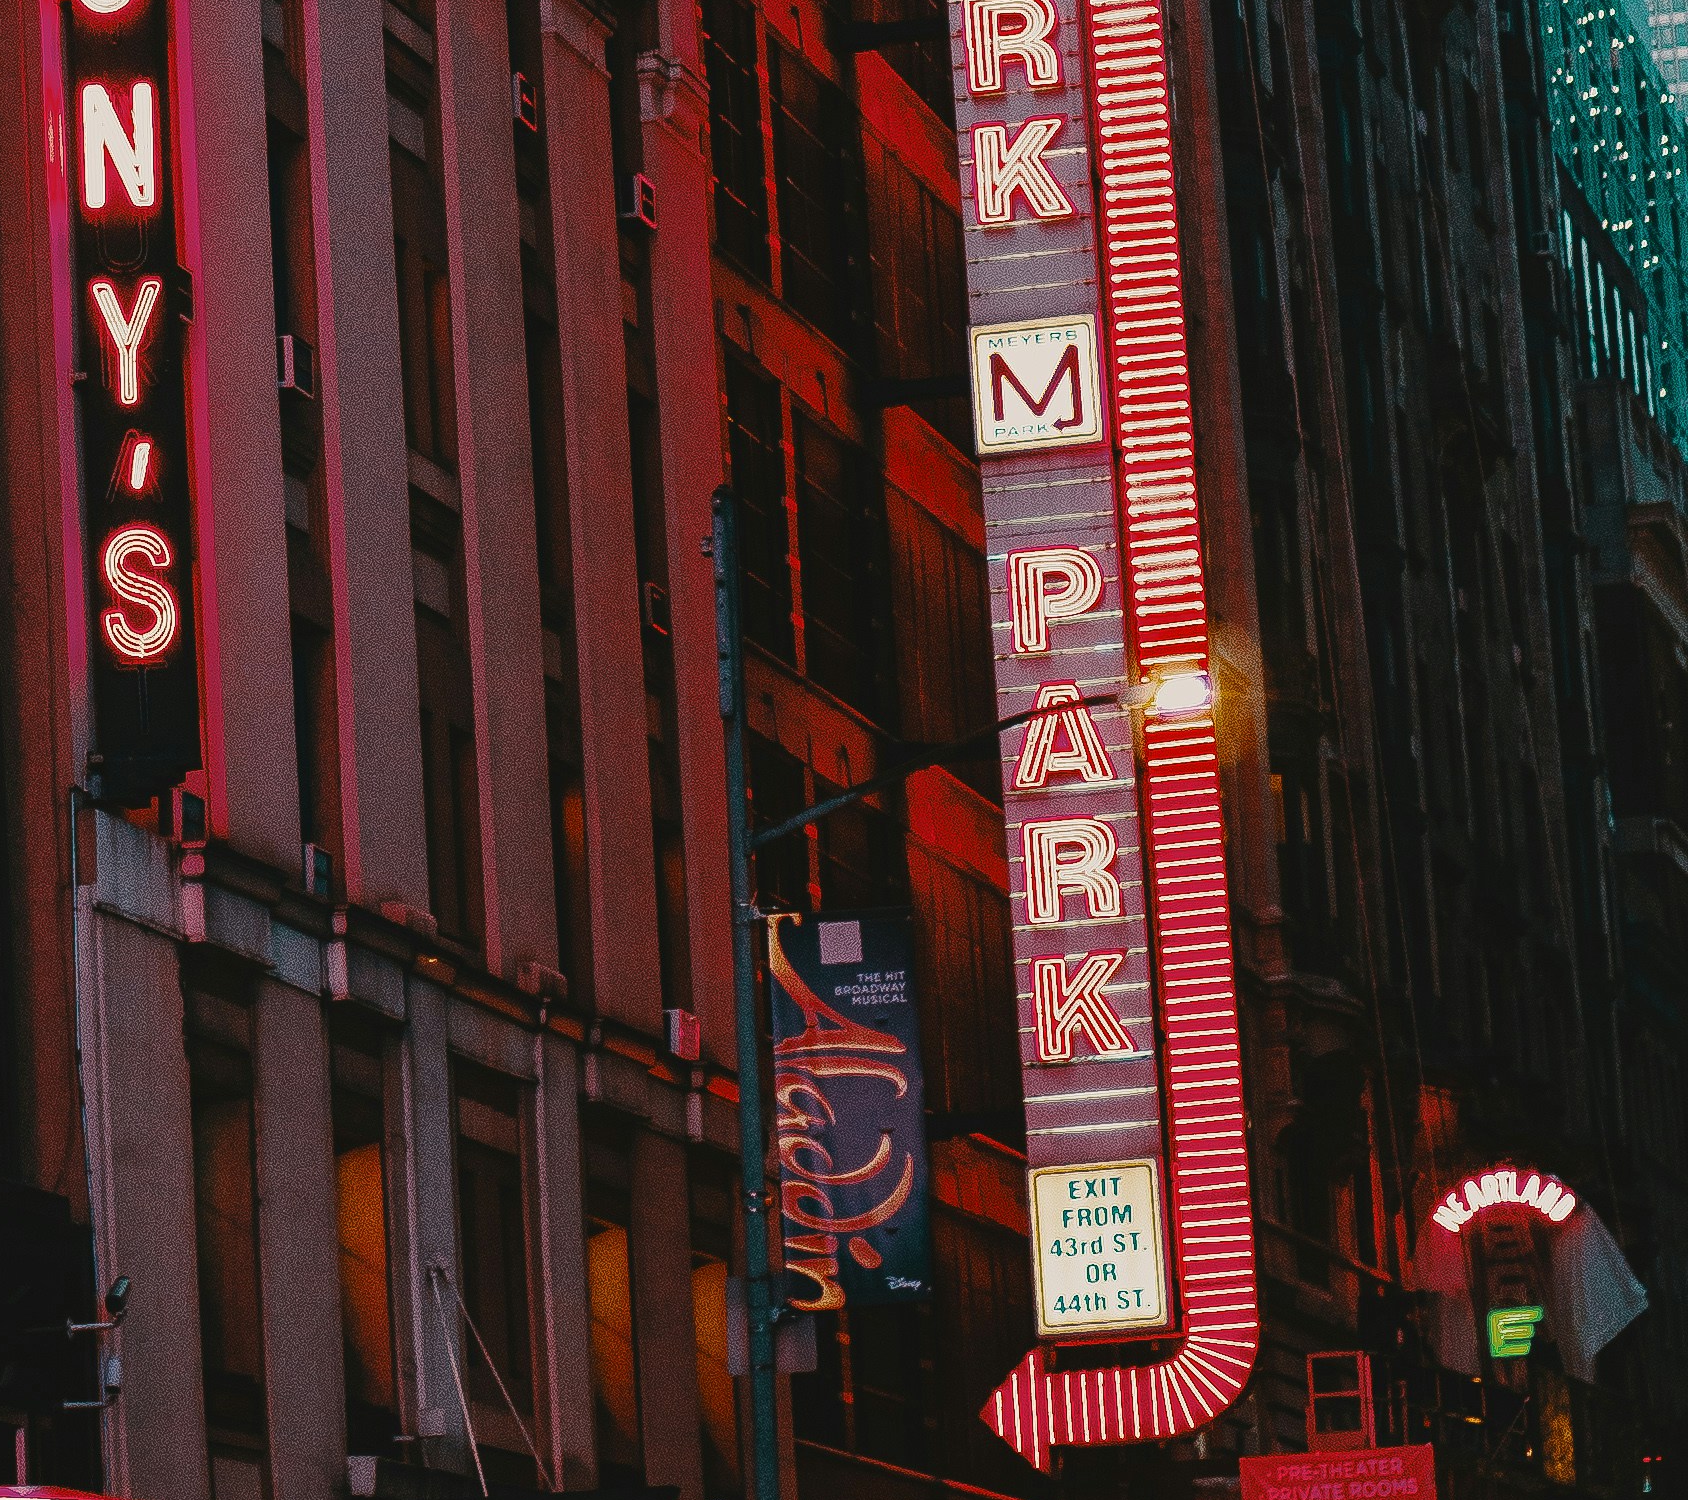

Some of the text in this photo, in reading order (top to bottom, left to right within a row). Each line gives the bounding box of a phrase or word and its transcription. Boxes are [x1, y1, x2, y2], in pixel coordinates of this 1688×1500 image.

[988, 330, 1078, 349] MEYERS
[994, 424, 1050, 438] PARK
[1008, 546, 1136, 1063] PARK
[856, 970, 907, 983] THE HIT
[833, 982, 907, 997] BROADWAY
[851, 993, 908, 1006] MUSICAL
[1068, 1177, 1122, 1200] EXIT
[1432, 1171, 1576, 1233] HEARTLAND
[1062, 1204, 1132, 1228] FROM
[1050, 1232, 1148, 1257] 43rd ST.
[1086, 1263, 1117, 1283] OR
[1053, 1289, 1151, 1314] 44th ST.
[1276, 1456, 1404, 1481] PRE-THEATER
[1348, 1477, 1419, 1498] ROOMS
